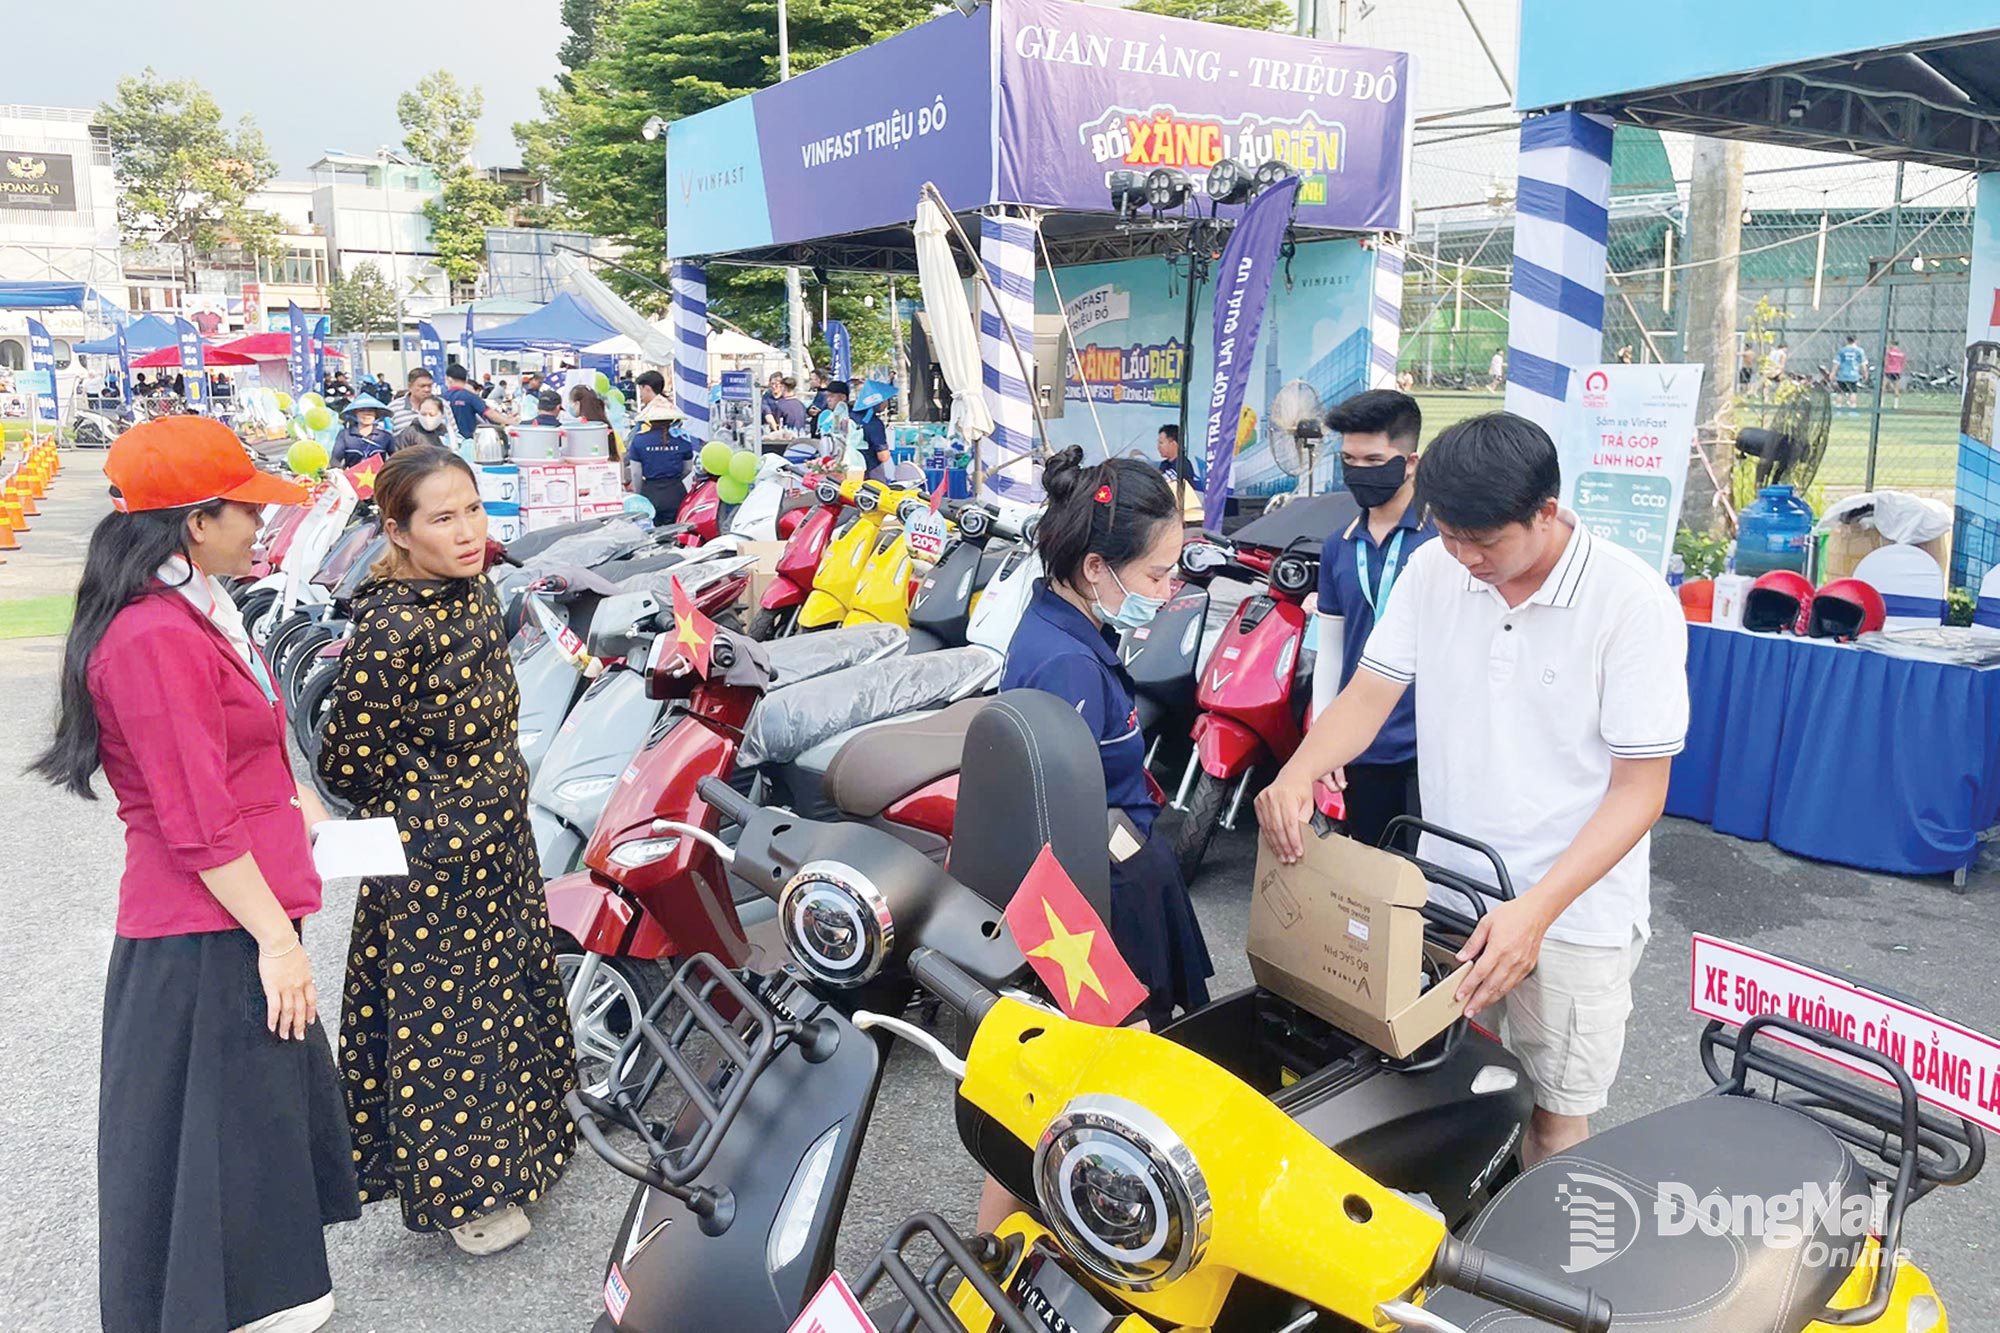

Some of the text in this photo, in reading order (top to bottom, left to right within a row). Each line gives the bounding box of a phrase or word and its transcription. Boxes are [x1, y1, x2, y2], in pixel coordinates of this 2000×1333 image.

[1015, 24, 1110, 68] GIAN
[1118, 33, 1221, 82] HÀNG
[1248, 56, 1349, 102] TRIỆU
[1352, 64, 1398, 104] ĐÔ
[802, 94, 947, 169] VINFAST TRIỆU ĐÔ
[1126, 114, 1222, 166] XĂNG
[697, 166, 744, 192] VINFAST
[1301, 275, 1350, 287] VINFAST
[1072, 312, 1093, 331] RIỆU
[420, 340, 439, 350] Thu
[189, 382, 200, 400] 1
[1212, 371, 1229, 407] GÓP
[1618, 419, 1628, 427] xe
[1631, 417, 1667, 428] VinFast
[1601, 431, 1658, 448] TRẢ GÓP
[1593, 453, 1662, 472] LINH HOẠT
[1579, 489, 1591, 505] 3
[1631, 493, 1667, 508] CCCD
[912, 535, 940, 552] 20%
[365, 700, 390, 710] GUCCI
[422, 710, 447, 720] GUCCI
[345, 731, 370, 740] GUCCI
[472, 829, 492, 846] GUCCI
[438, 855, 463, 865] GUCCI
[454, 946, 476, 957] GUCCI
[1324, 944, 1338, 958] PIN
[1322, 965, 1358, 986] VINFAST
[471, 1035, 495, 1048] GUCCI
[1704, 965, 1728, 1006] XE
[1788, 991, 1856, 1042] KHÔNG
[1863, 1013, 1906, 1068] CẦN
[1912, 1030, 1972, 1103] BẰNG
[393, 1044, 414, 1061] GUCCI
[418, 1135, 439, 1154] GUCCI
